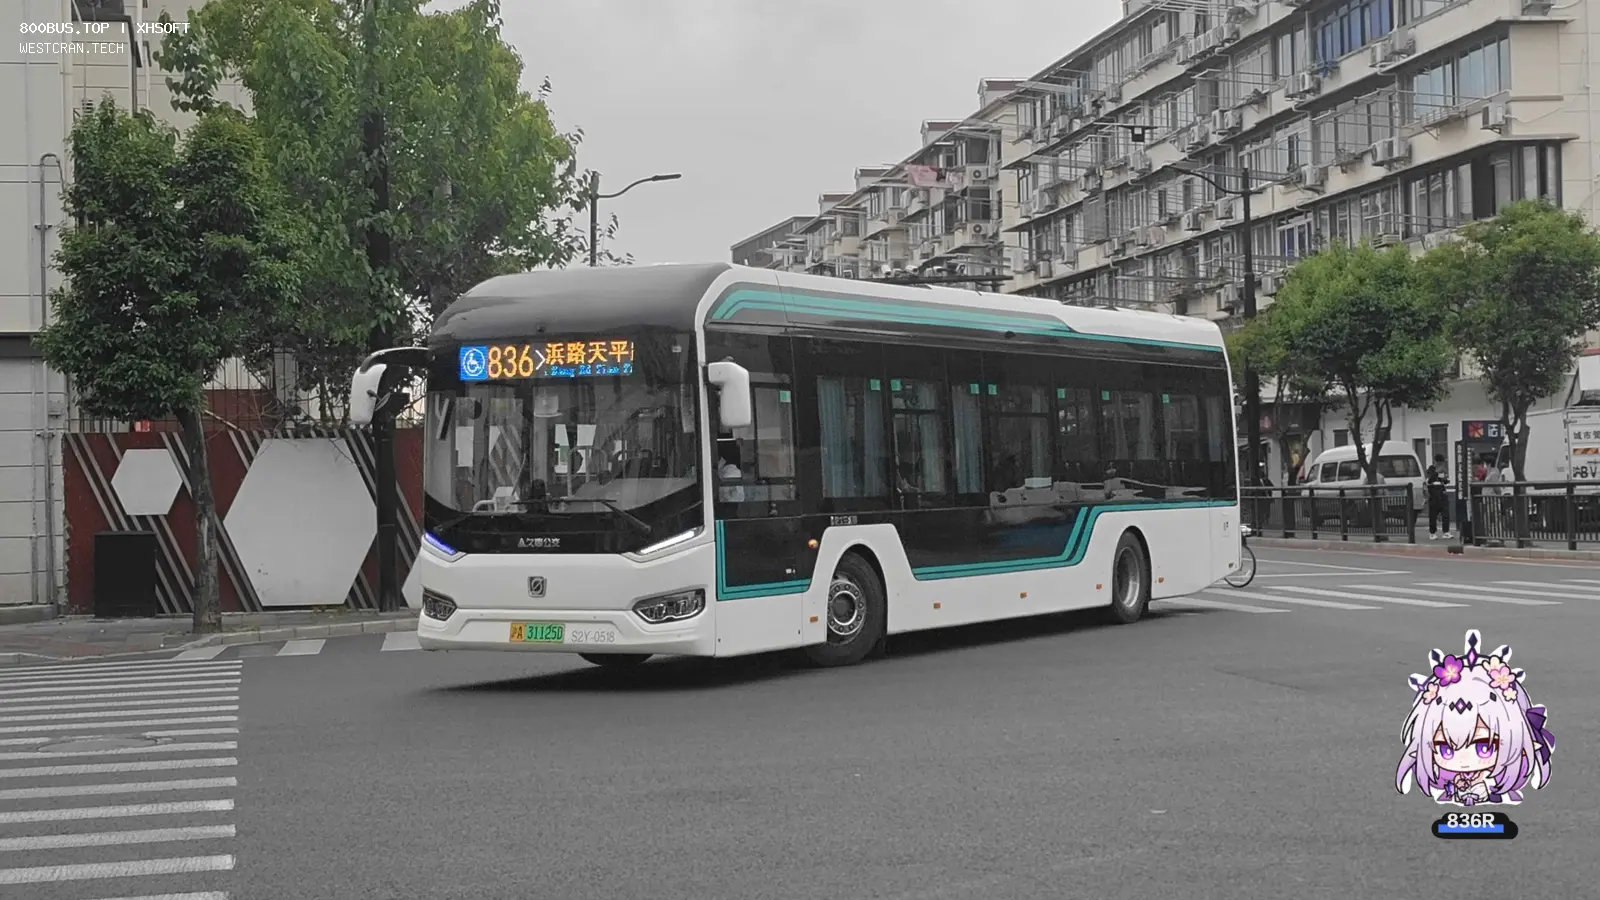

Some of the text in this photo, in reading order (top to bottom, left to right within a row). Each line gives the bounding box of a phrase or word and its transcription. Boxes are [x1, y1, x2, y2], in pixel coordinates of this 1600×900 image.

[488, 345, 533, 378] 836
[545, 340, 634, 365] 浜路天平
[527, 625, 563, 641] 31125D
[571, 630, 615, 643] S2Y-0518
